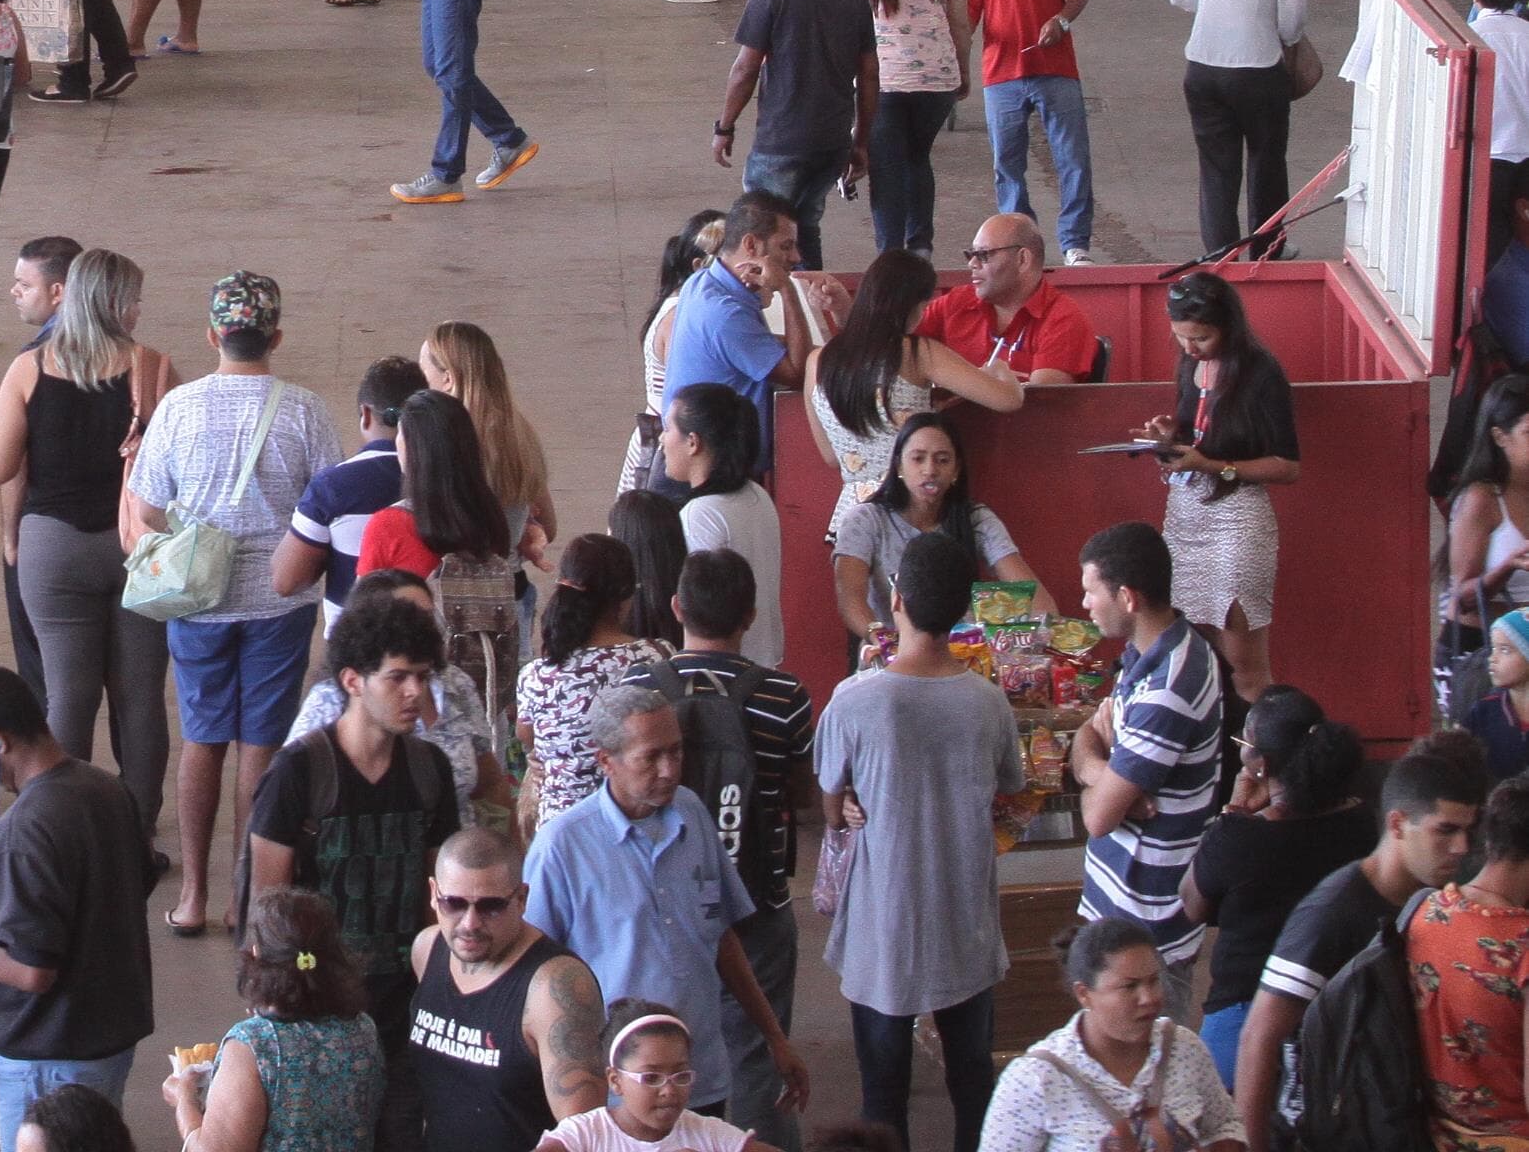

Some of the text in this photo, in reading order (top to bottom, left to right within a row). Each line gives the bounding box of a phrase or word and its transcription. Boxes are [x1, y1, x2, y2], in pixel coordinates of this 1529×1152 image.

[410, 1025, 501, 1067] DE MALDADE!
[415, 1008, 482, 1046] HOJE É DIA
